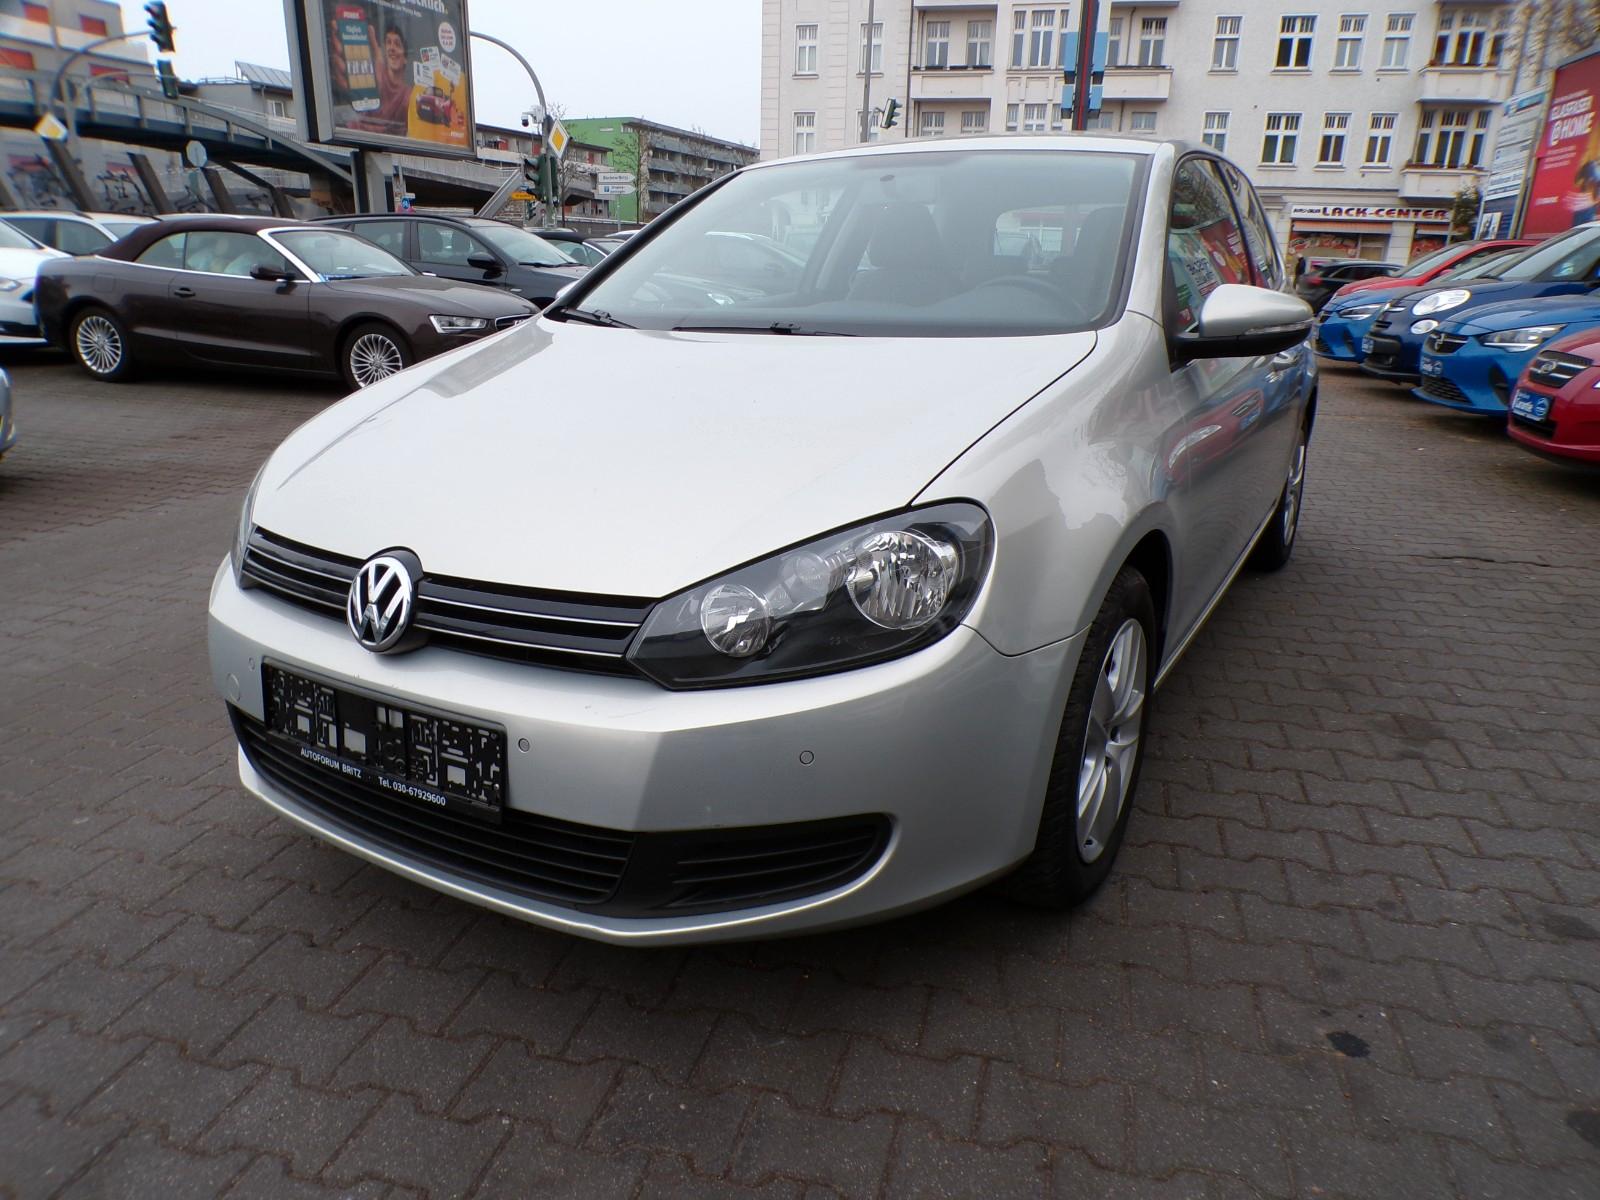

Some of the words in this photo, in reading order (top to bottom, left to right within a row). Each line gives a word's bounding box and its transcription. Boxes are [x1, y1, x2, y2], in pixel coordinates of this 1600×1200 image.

[1321, 206, 1449, 220] LACK-CENTER
[300, 747, 340, 769] AUTOFORUM
[342, 762, 362, 779] BRITZ
[378, 776, 392, 789] Tel.
[392, 782, 446, 806] 030-67929600
